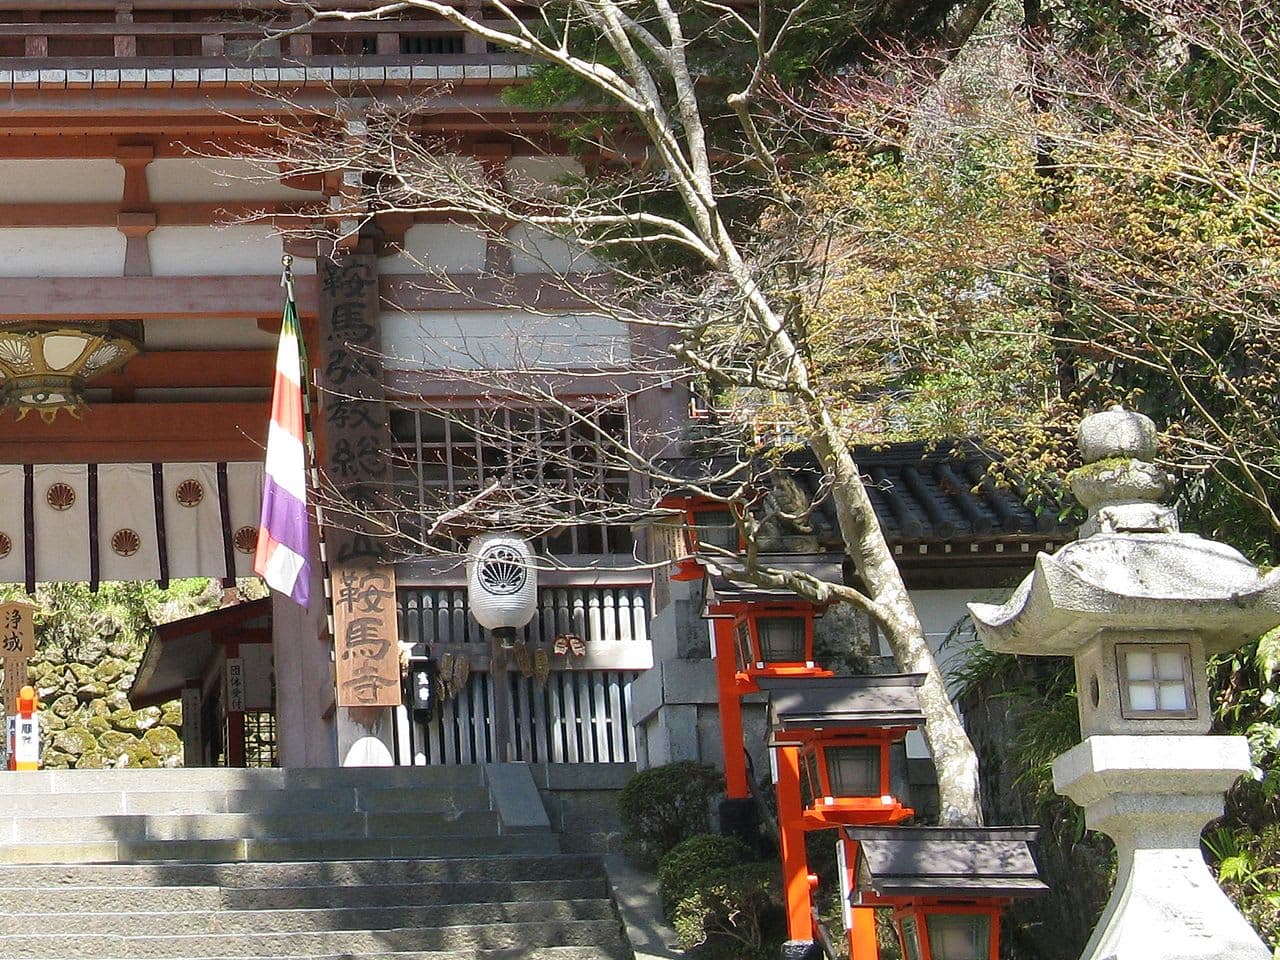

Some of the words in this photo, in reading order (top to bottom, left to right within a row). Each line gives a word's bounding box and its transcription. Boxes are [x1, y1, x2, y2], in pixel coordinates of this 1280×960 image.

[2, 609, 24, 652] 浄域
[336, 569, 398, 704] 鞍馬寺
